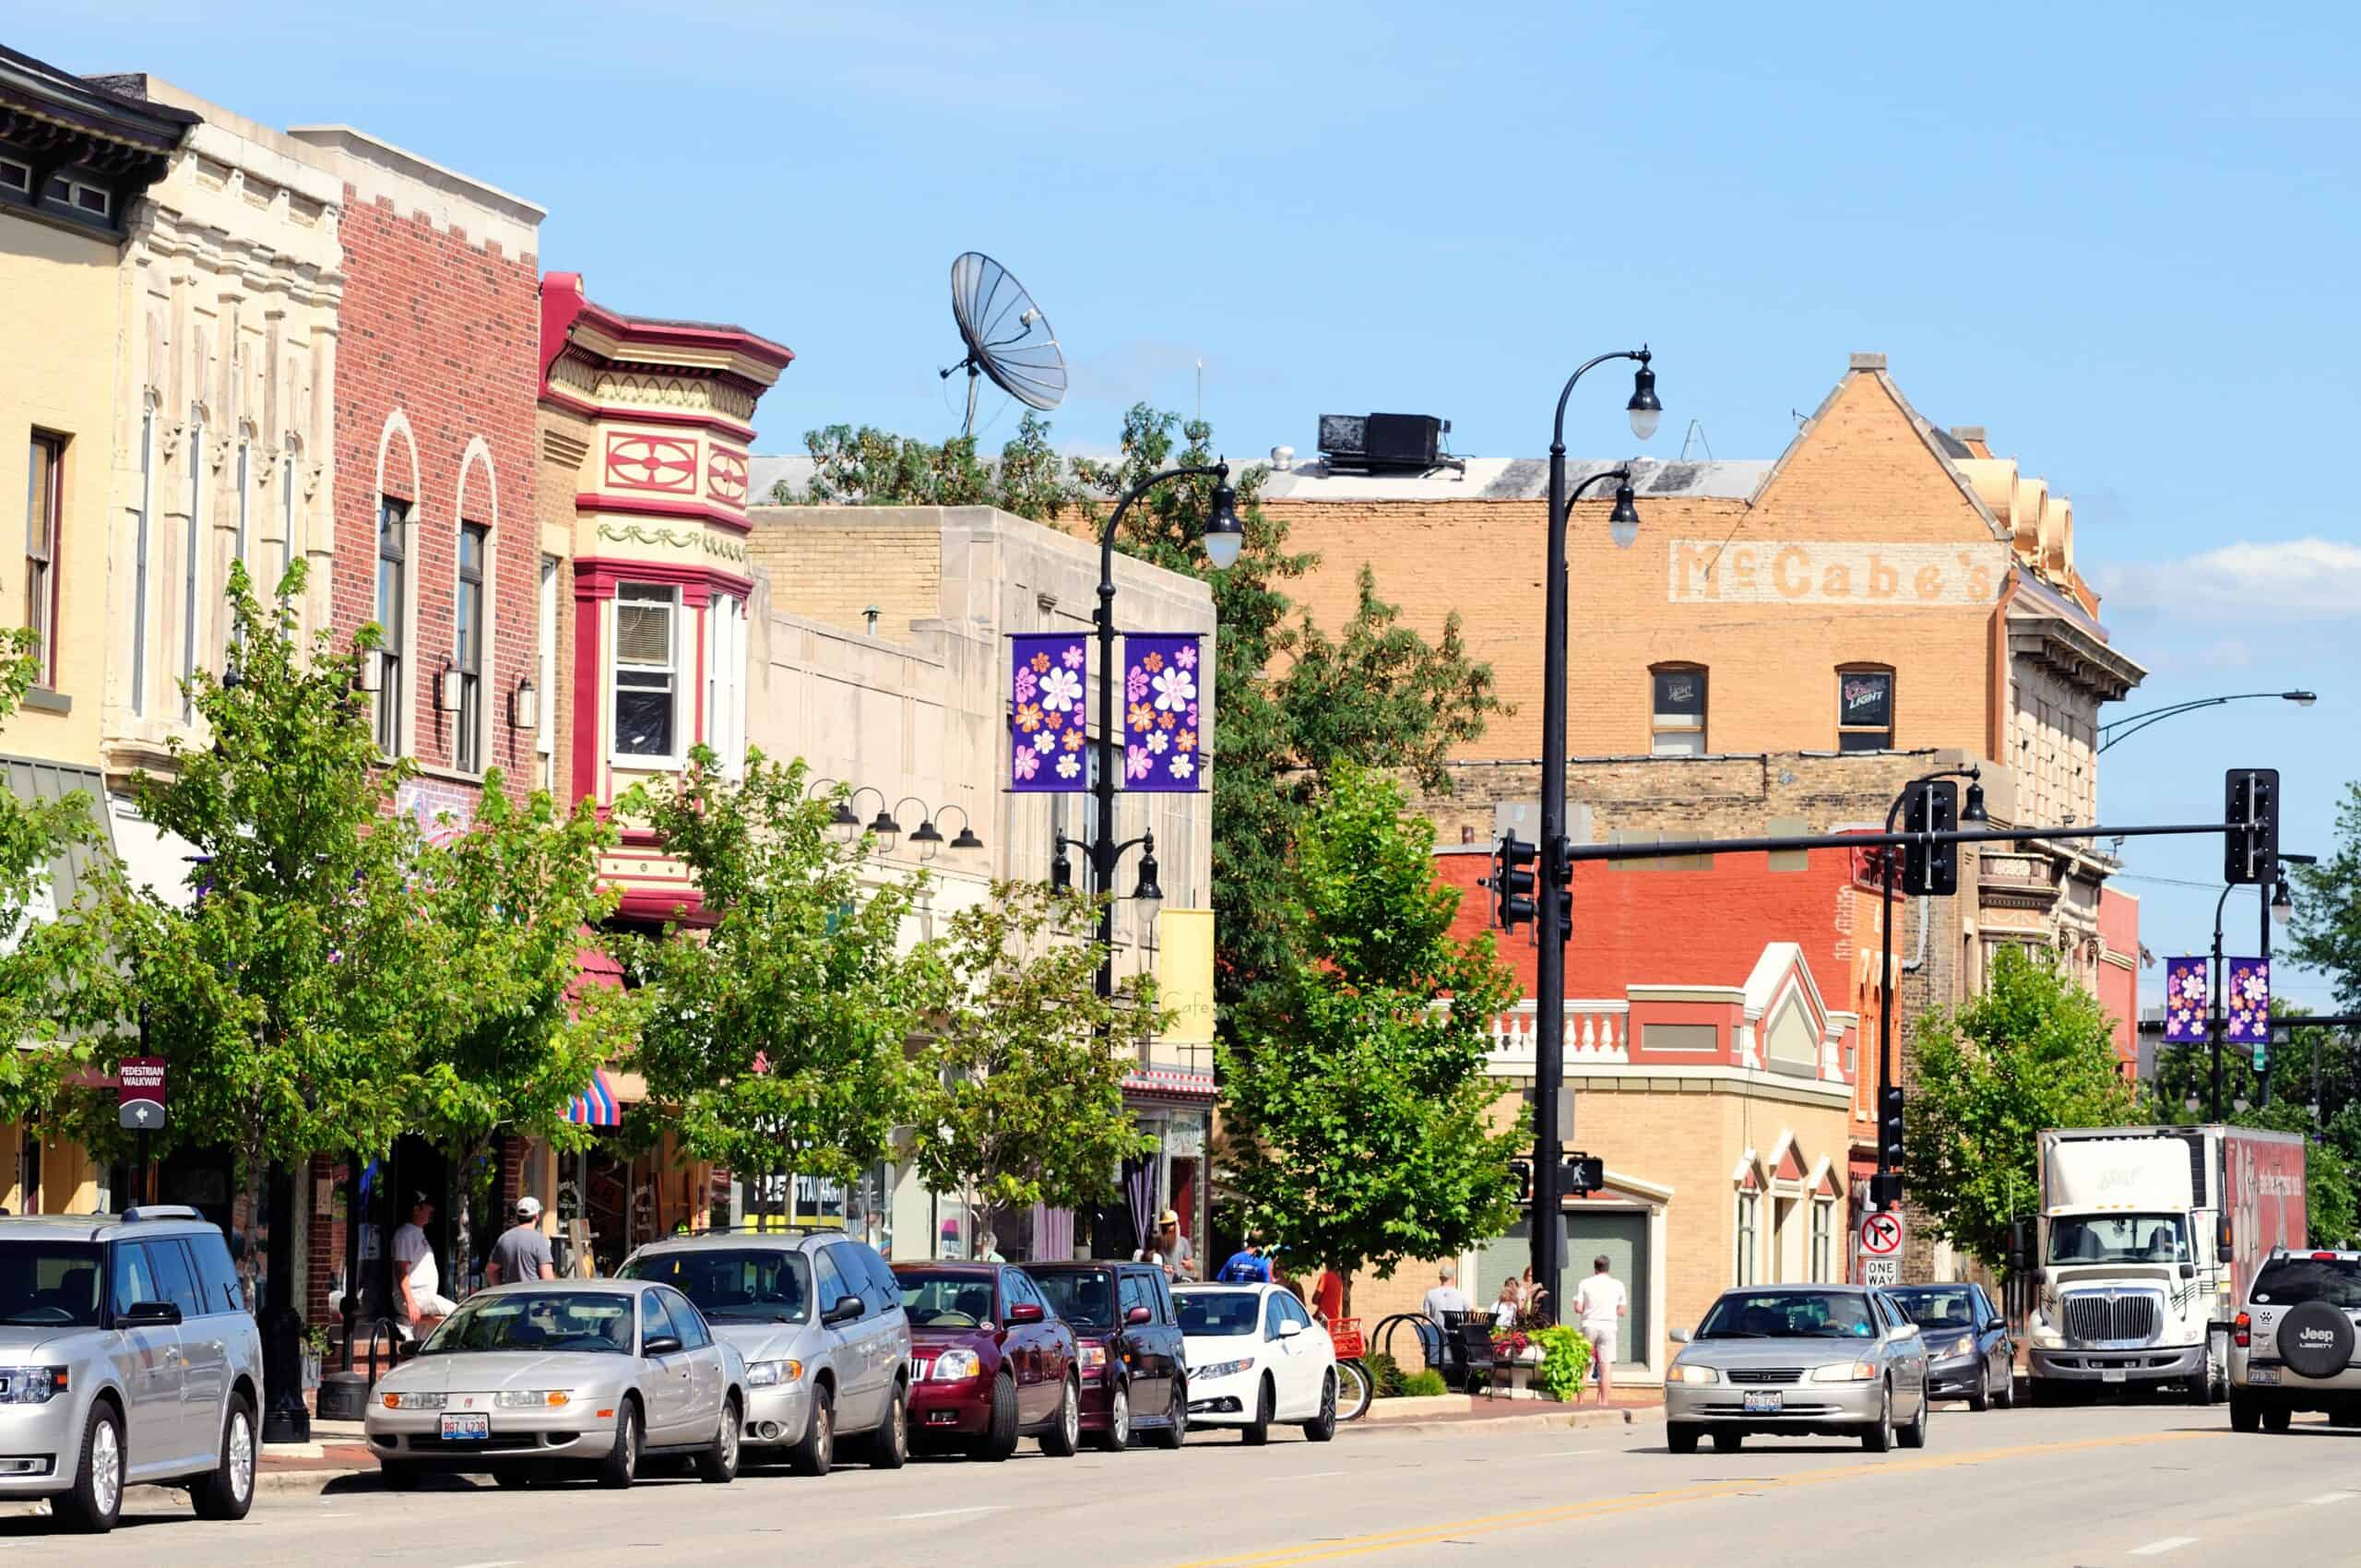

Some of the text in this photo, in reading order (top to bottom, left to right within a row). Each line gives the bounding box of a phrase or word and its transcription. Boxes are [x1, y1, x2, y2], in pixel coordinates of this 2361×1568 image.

[1676, 544, 1991, 601] McCabe's
[1849, 691, 1883, 709] LIGHT
[1162, 991, 1209, 1018] Cafe
[121, 1066, 164, 1076] PEDESTRIAN
[123, 1076, 161, 1087] WALKWAY
[1869, 1262, 1893, 1273] ONE
[1869, 1276, 1894, 1286] WAY
[2299, 1326, 2333, 1343] Jeep
